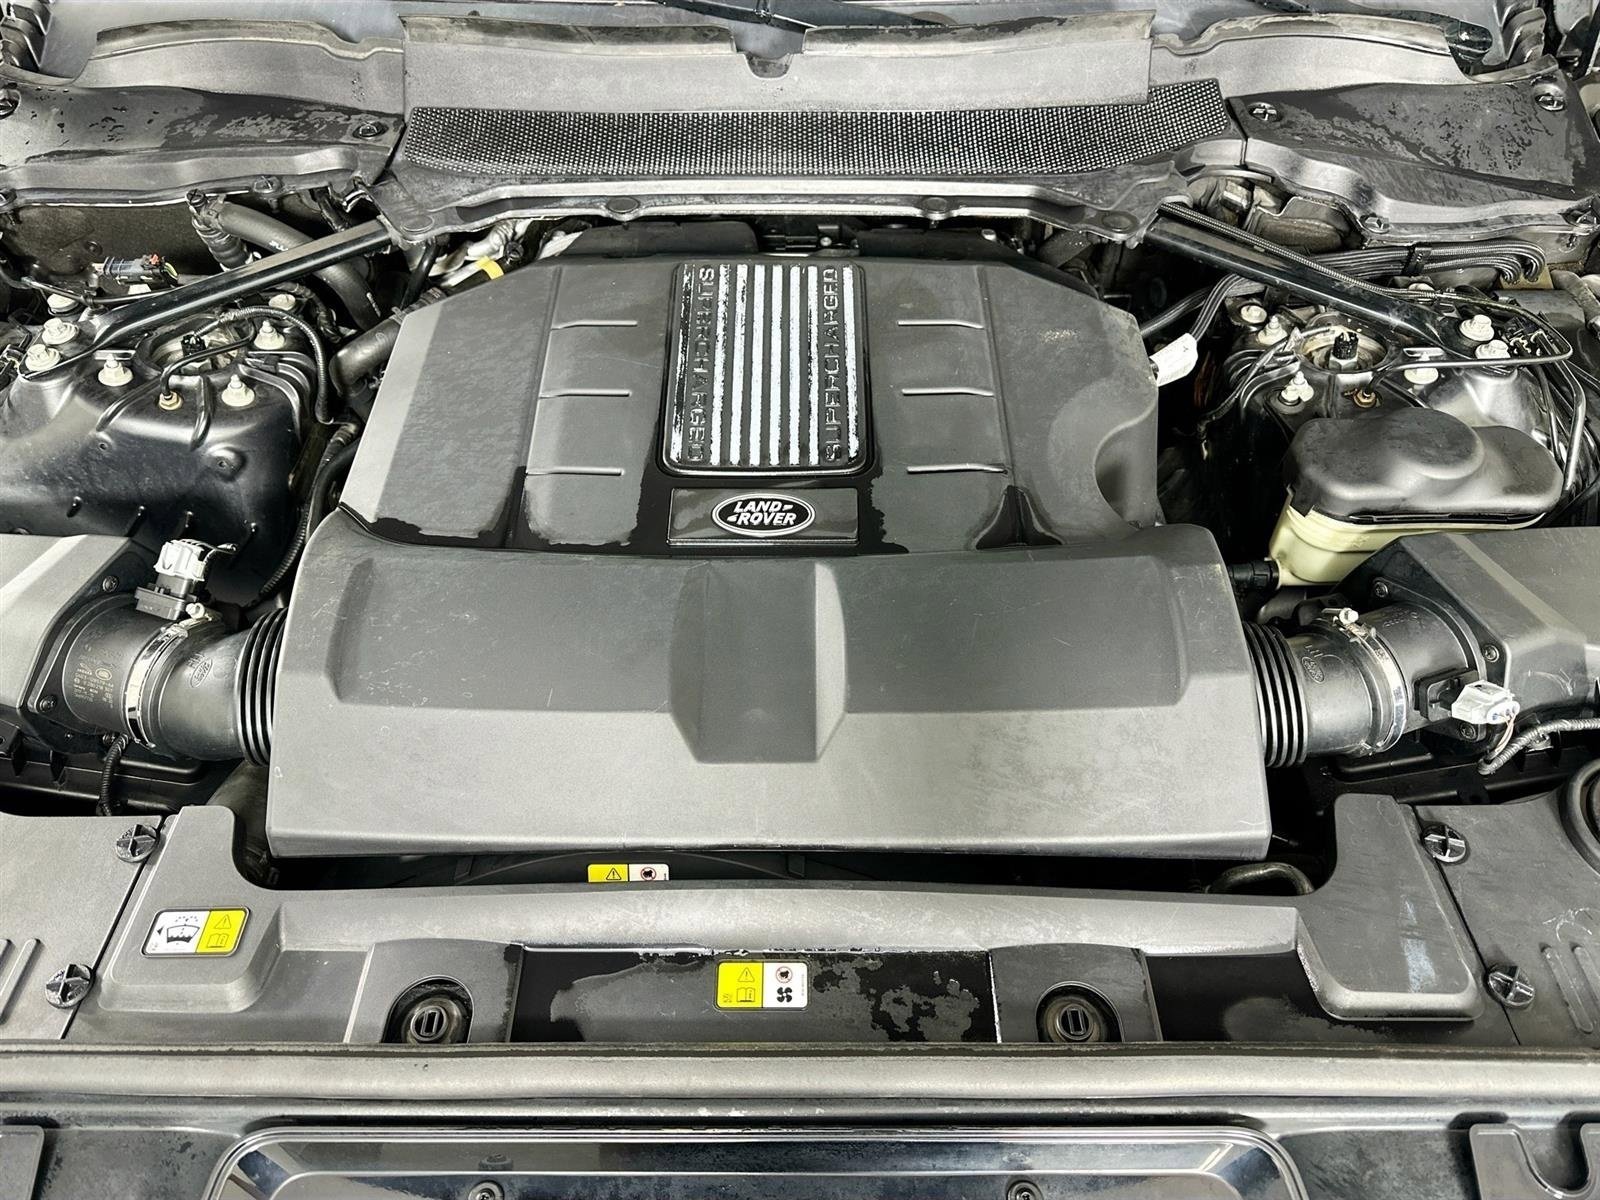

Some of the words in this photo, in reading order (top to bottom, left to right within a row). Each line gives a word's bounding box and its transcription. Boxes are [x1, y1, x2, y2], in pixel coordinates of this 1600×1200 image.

[687, 267, 714, 462] SUPERCHARGED
[823, 267, 841, 462] SUPERCHARGED
[733, 500, 782, 513] LAND
[736, 512, 797, 526] ROVER
